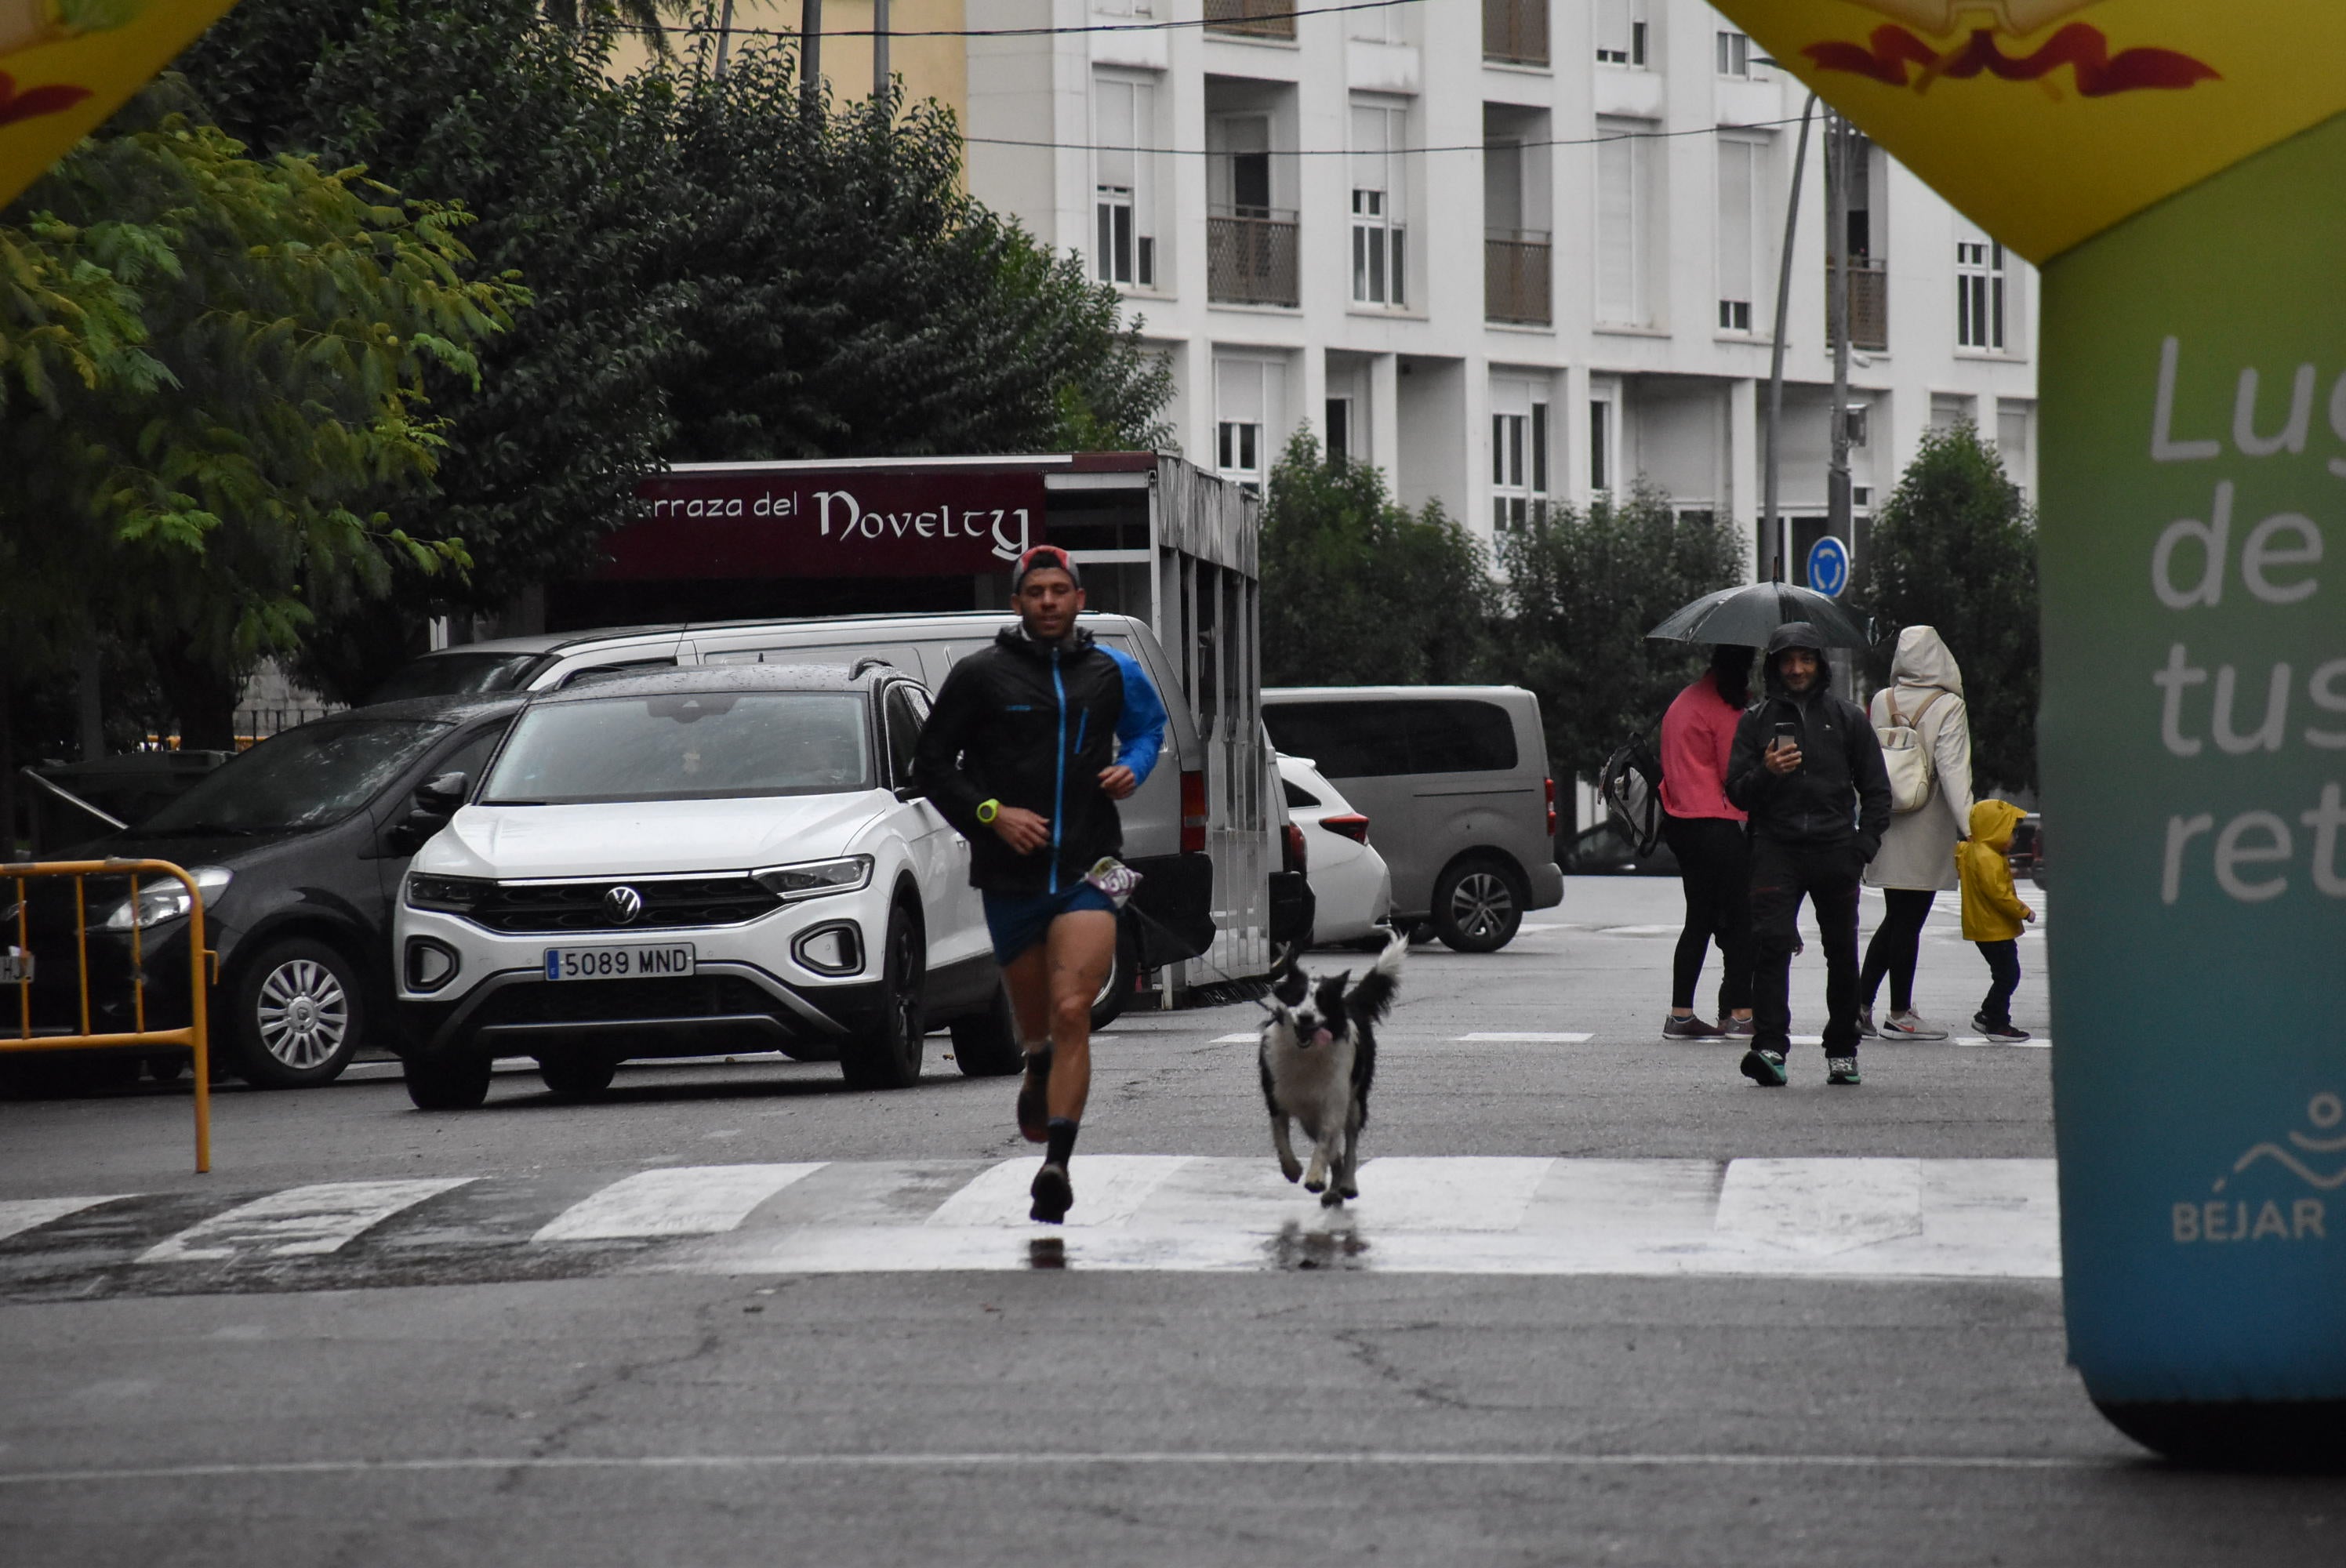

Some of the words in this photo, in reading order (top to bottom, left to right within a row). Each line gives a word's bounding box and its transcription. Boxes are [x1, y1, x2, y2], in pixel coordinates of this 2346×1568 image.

[2152, 336, 2346, 477] Lu
[654, 499, 743, 517] rraza
[754, 490, 797, 516] del
[811, 490, 1029, 561] Novelty
[2153, 480, 2324, 608] de
[565, 951, 629, 976] 5089
[639, 949, 687, 973] MND
[2172, 1178, 2326, 1243] BÉJAR
